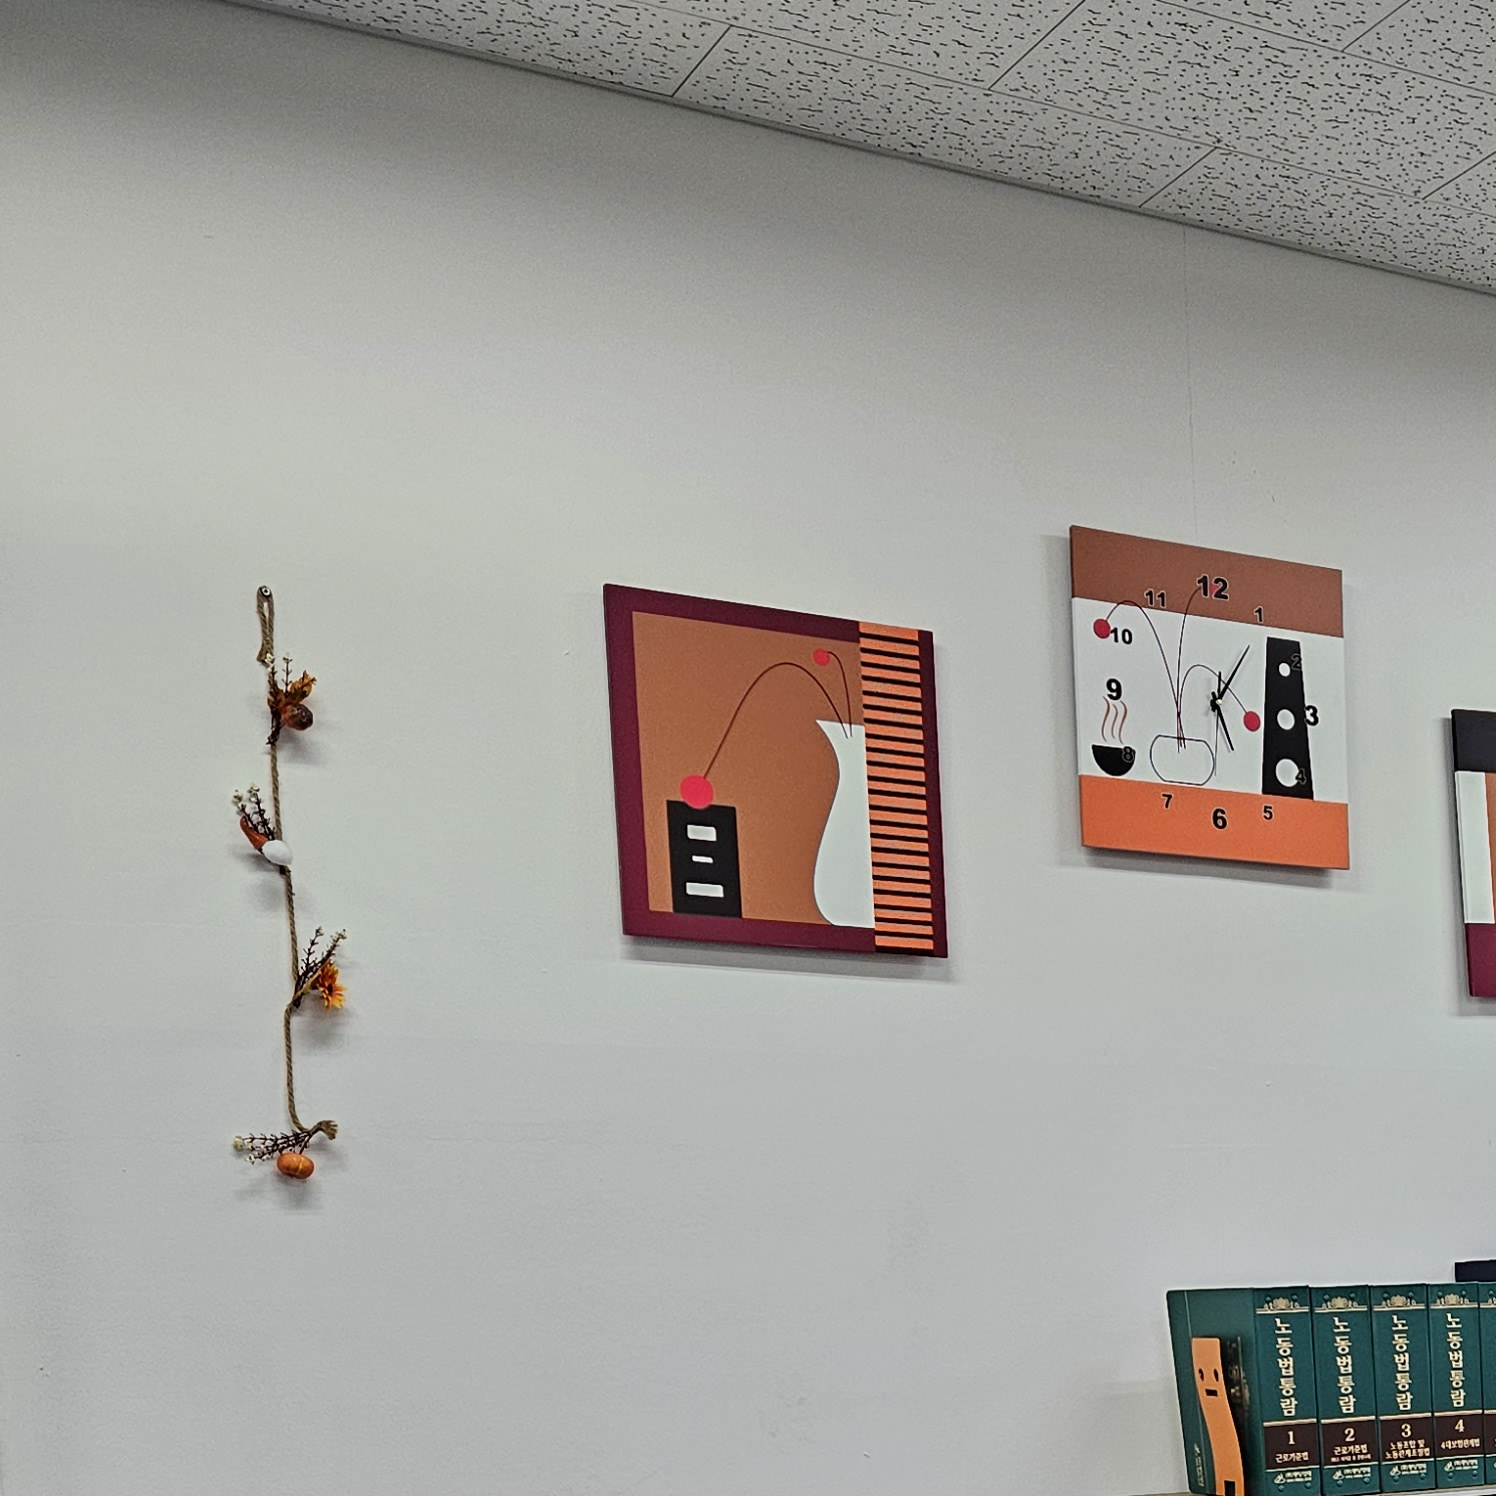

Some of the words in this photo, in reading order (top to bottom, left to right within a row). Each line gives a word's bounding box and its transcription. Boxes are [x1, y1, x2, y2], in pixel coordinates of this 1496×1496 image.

[1197, 575, 1229, 600] 12
[1144, 589, 1167, 608] 11
[1254, 607, 1264, 623] 1
[1110, 627, 1133, 645] 10
[1290, 653, 1303, 671] 2
[1105, 678, 1123, 701] 9
[1304, 704, 1319, 727] 3
[1121, 746, 1137, 763] 8
[1294, 768, 1307, 785] 4
[1161, 793, 1173, 809] 7
[1212, 808, 1228, 830] 6
[1263, 806, 1274, 821] 5
[1275, 1318, 1298, 1417] 노동법통람
[1333, 1317, 1356, 1414] 노동법통람
[1391, 1315, 1414, 1411] 노동법통람
[1446, 1312, 1466, 1407] 노동법통람
[1401, 1423, 1412, 1438] 3
[1454, 1418, 1465, 1433] 4
[1287, 1430, 1296, 1445] 1
[1344, 1427, 1356, 1442] 2
[1275, 1451, 1309, 1463] 근로기준법
[1333, 1444, 1368, 1456] 근로기준법
